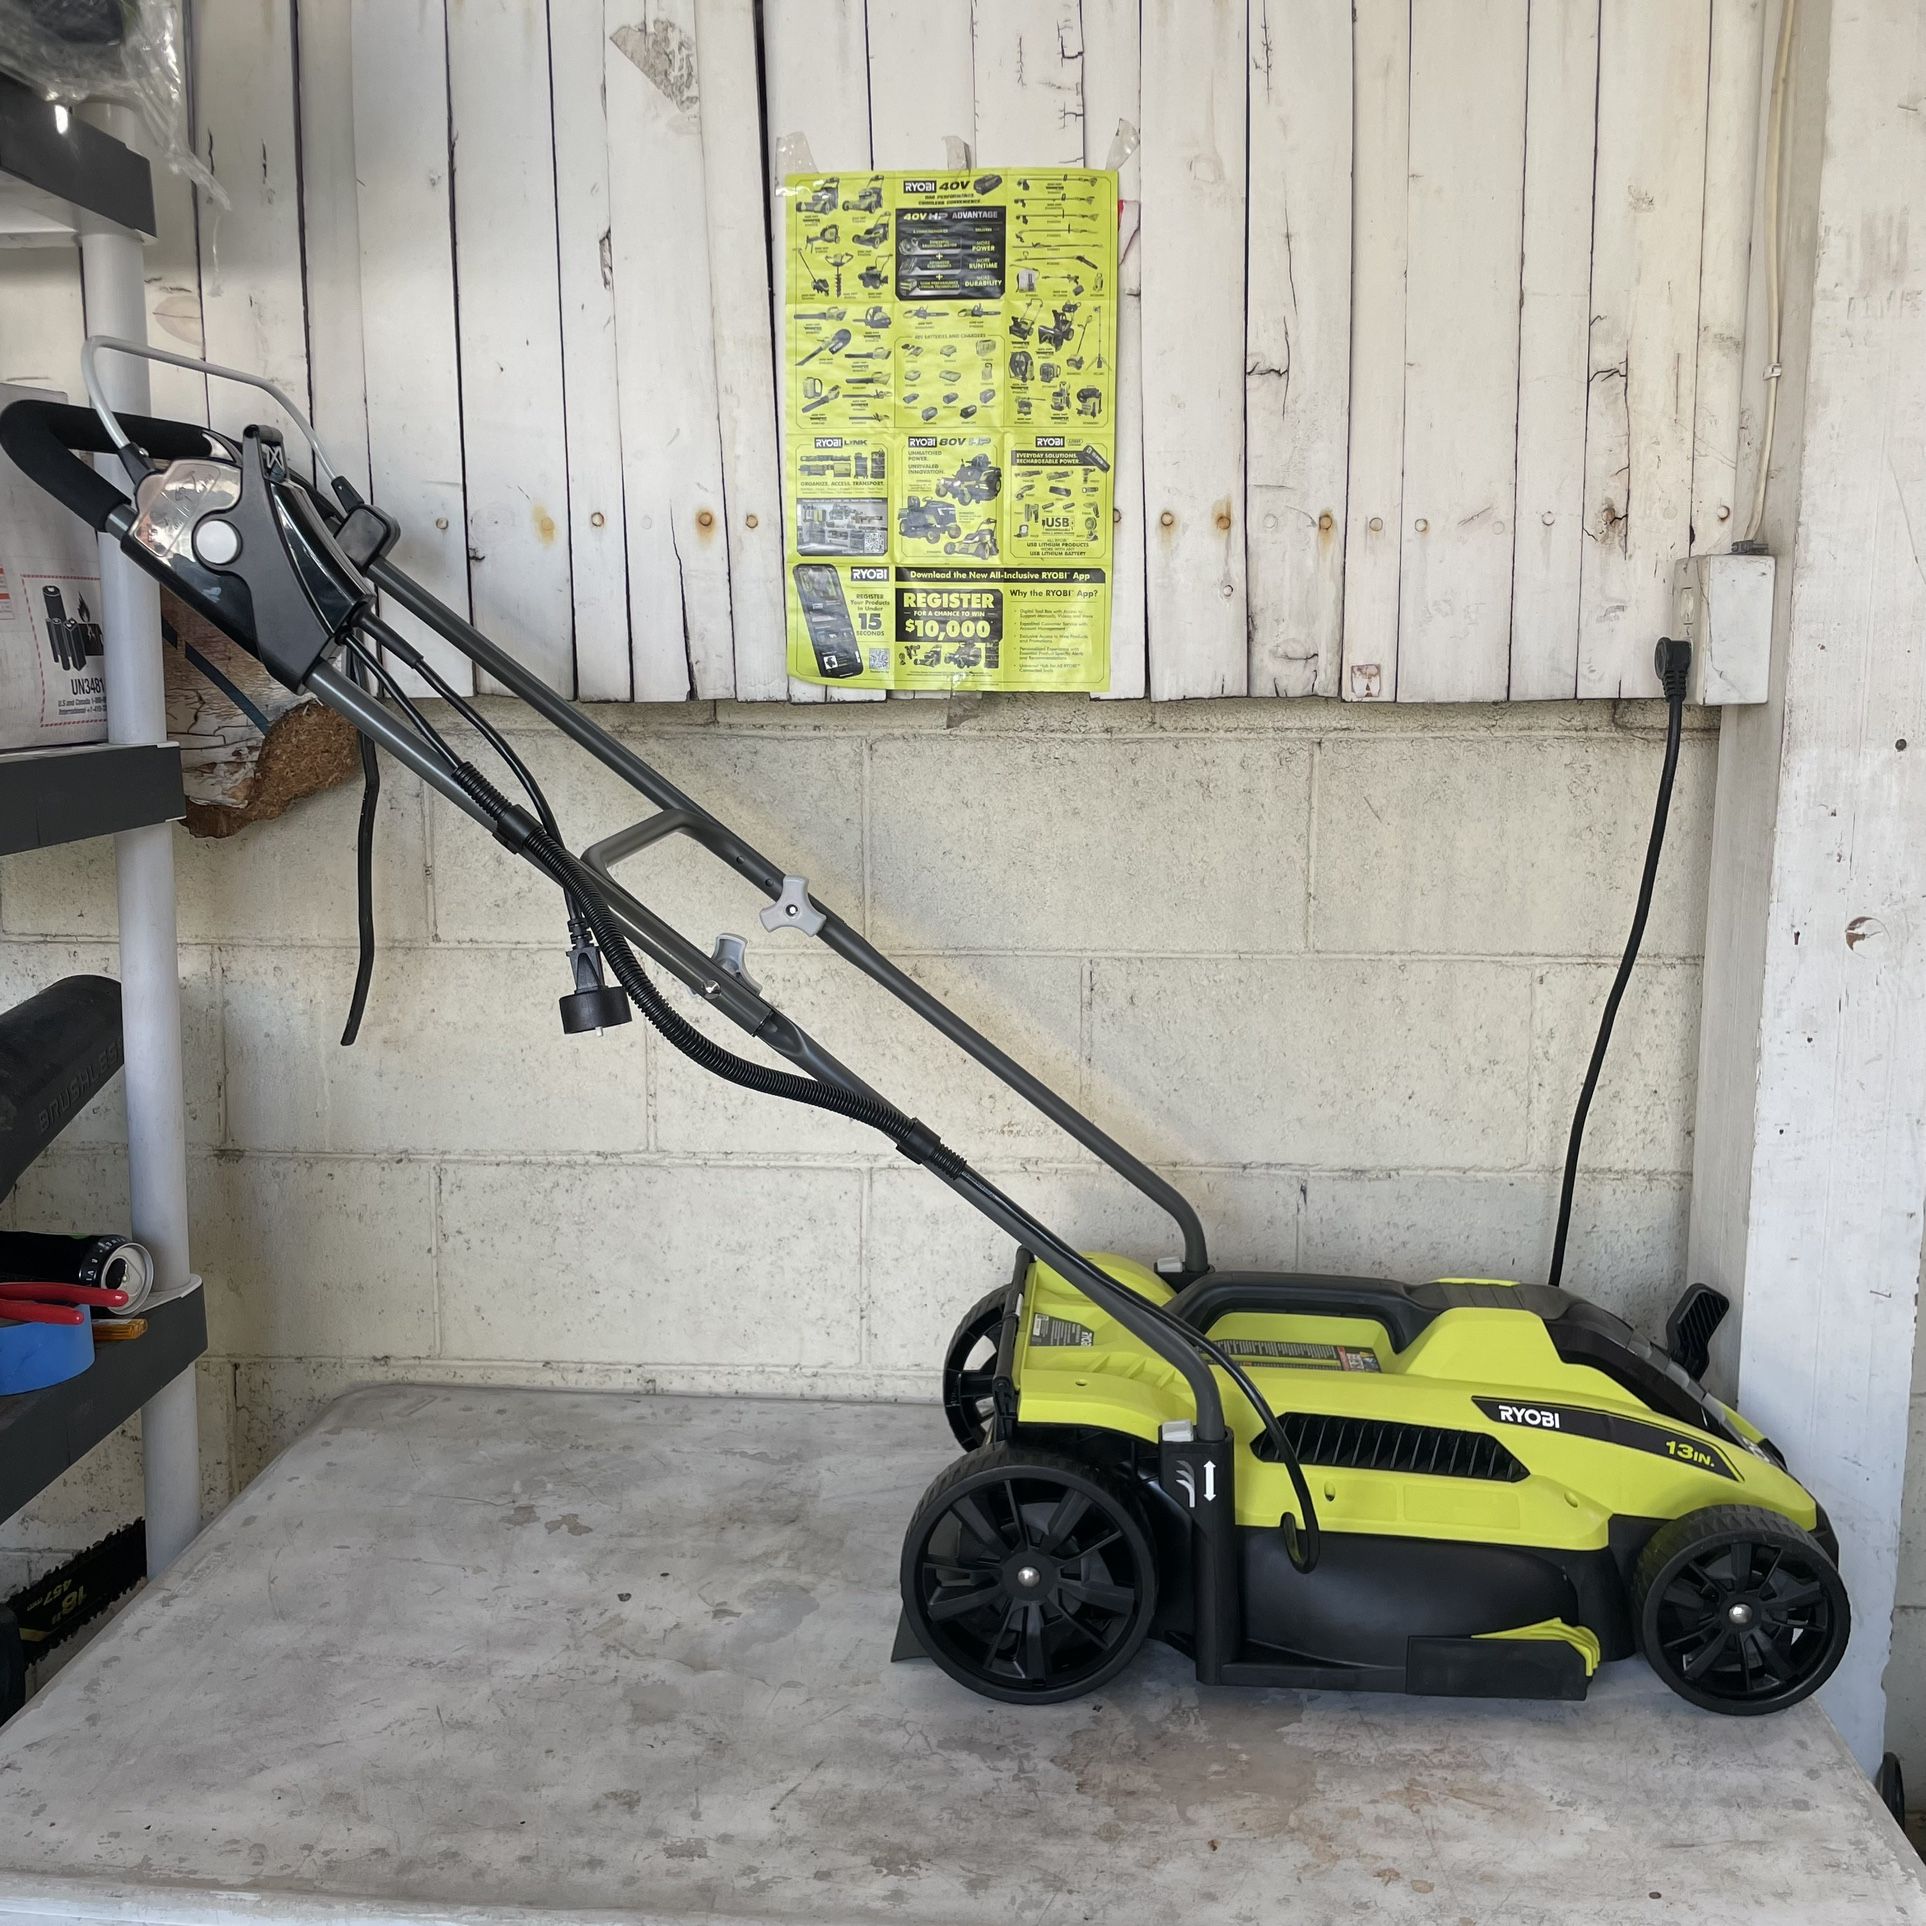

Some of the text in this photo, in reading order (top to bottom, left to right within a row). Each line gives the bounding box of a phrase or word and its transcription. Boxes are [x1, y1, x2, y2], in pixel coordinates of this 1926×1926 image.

[904, 180, 970, 192] RYOBI 40V
[909, 438, 936, 446] RYOBI
[939, 438, 966, 446] 80V
[1037, 438, 1064, 446] RYOBI
[1046, 518, 1069, 527] USB
[853, 569, 887, 579] RYOBI
[1073, 572, 1090, 581] App
[1010, 590, 1027, 598] Why
[1077, 590, 1098, 598] App?
[903, 592, 994, 608] REGISTER
[858, 613, 882, 630] 15
[70, 678, 105, 695] UN3481
[37, 1040, 122, 1134] BRUSHLES
[1499, 1405, 1560, 1429] RYOBI
